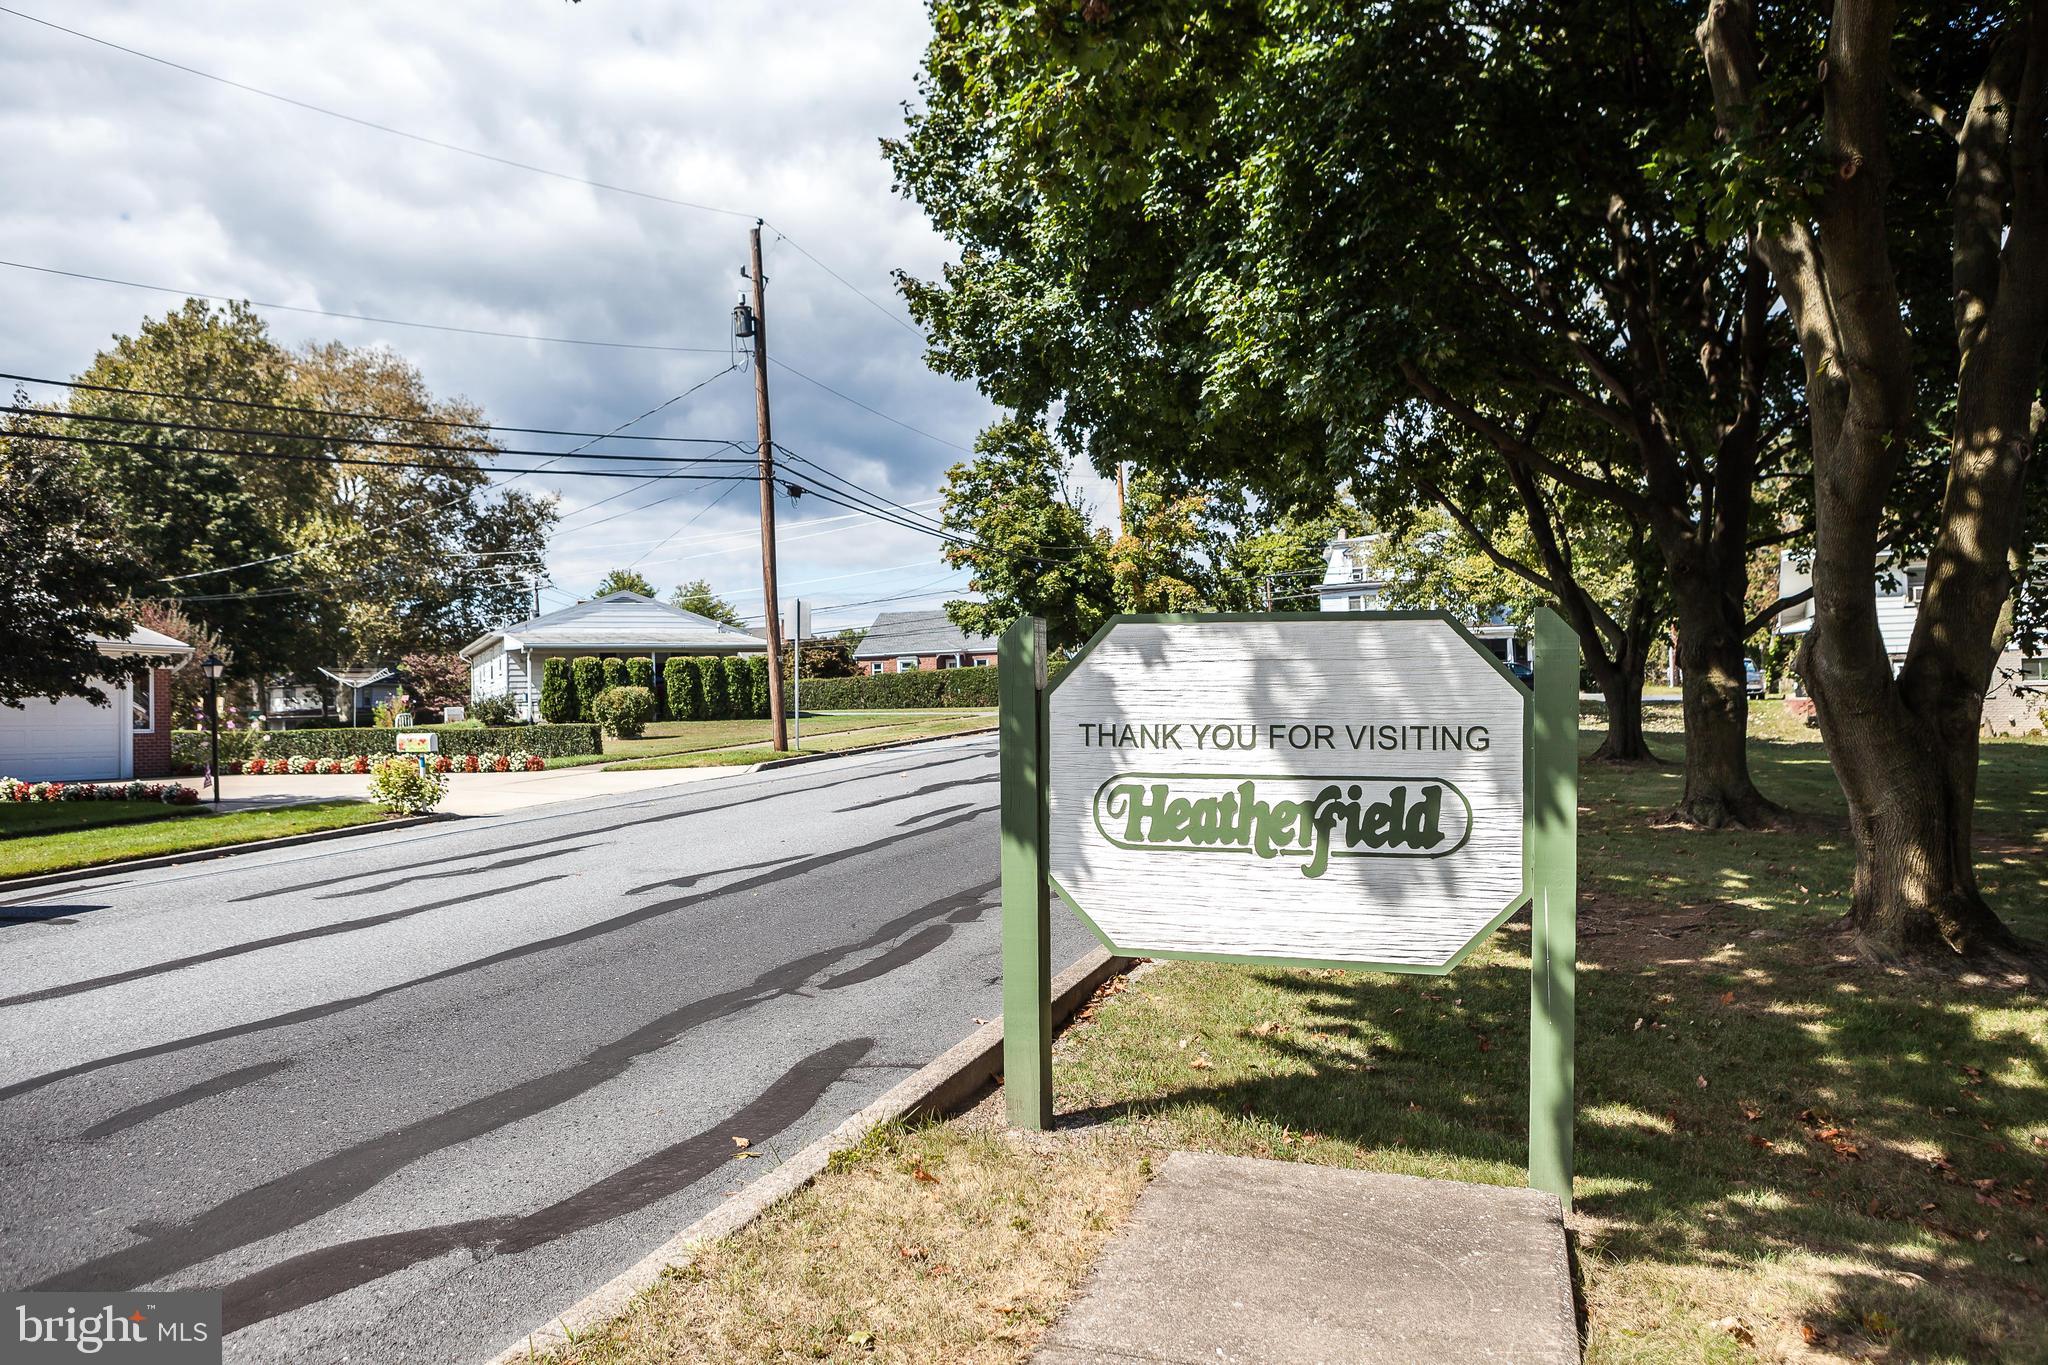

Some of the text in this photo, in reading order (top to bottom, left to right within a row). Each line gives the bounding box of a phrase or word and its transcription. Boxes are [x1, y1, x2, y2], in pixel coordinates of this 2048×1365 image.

[1079, 723, 1490, 751] THANK YOU FOR VISITING
[1107, 780, 1445, 878] Heatherfield
